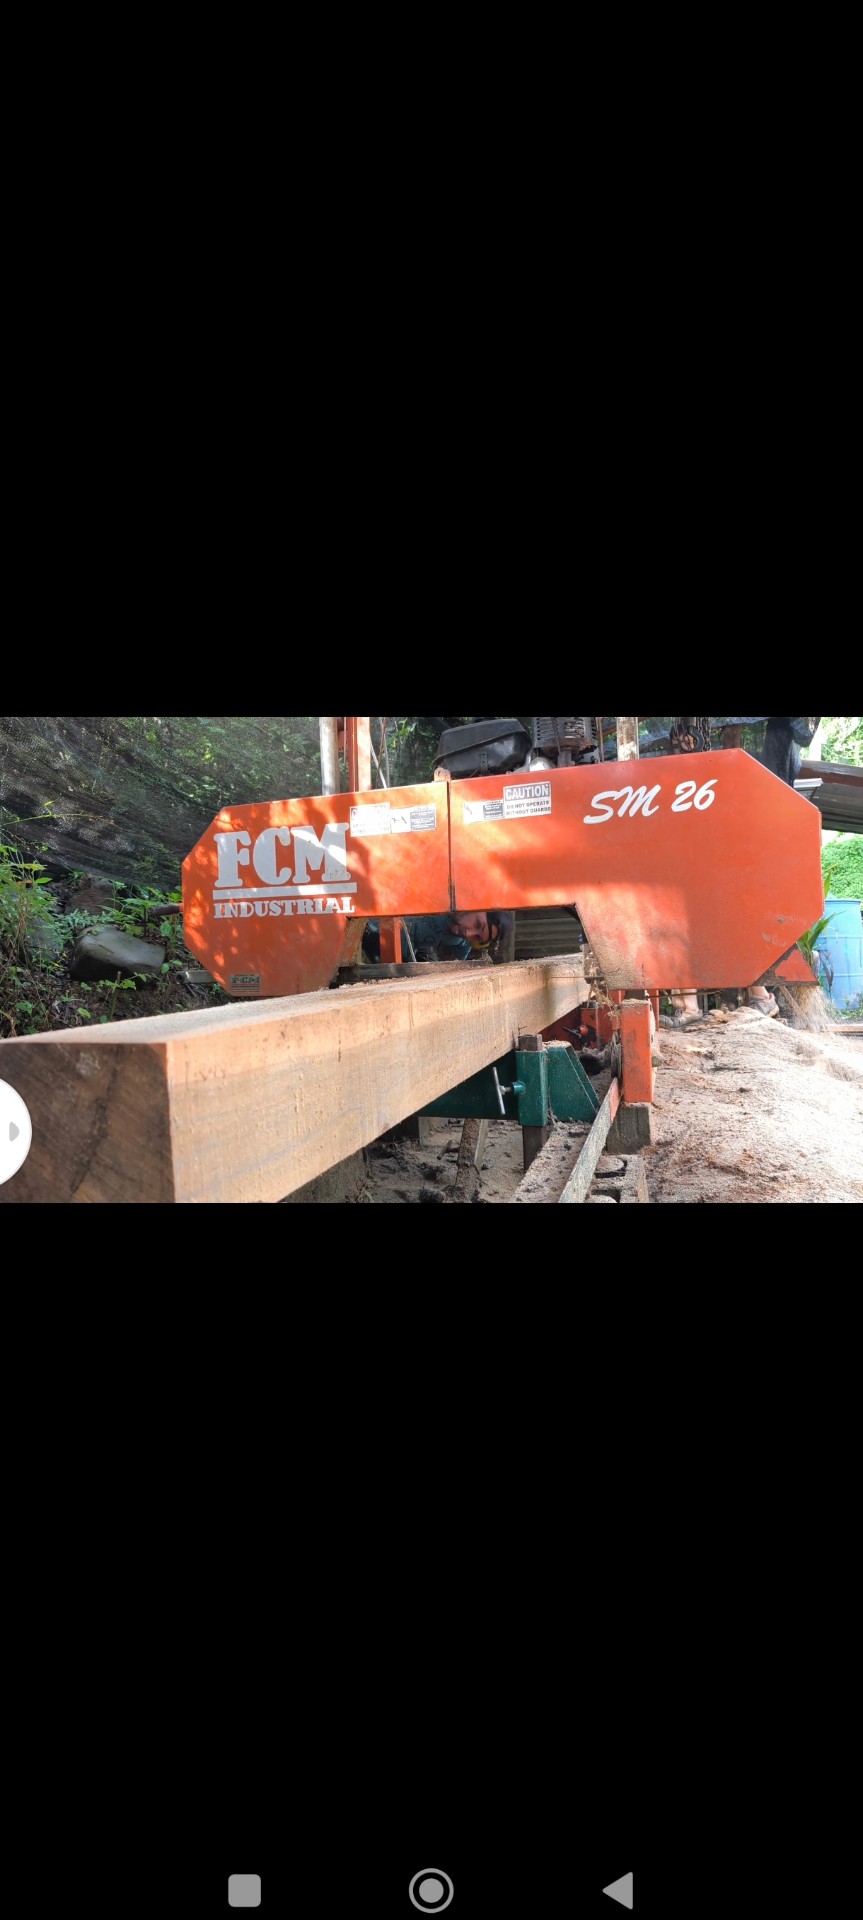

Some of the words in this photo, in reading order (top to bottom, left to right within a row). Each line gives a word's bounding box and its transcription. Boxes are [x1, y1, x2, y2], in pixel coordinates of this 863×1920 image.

[505, 785, 549, 800] CAUTION
[583, 784, 661, 824] SM
[671, 779, 718, 812] 26
[213, 822, 352, 888] FCM
[213, 896, 356, 919] INDUSTRIAL
